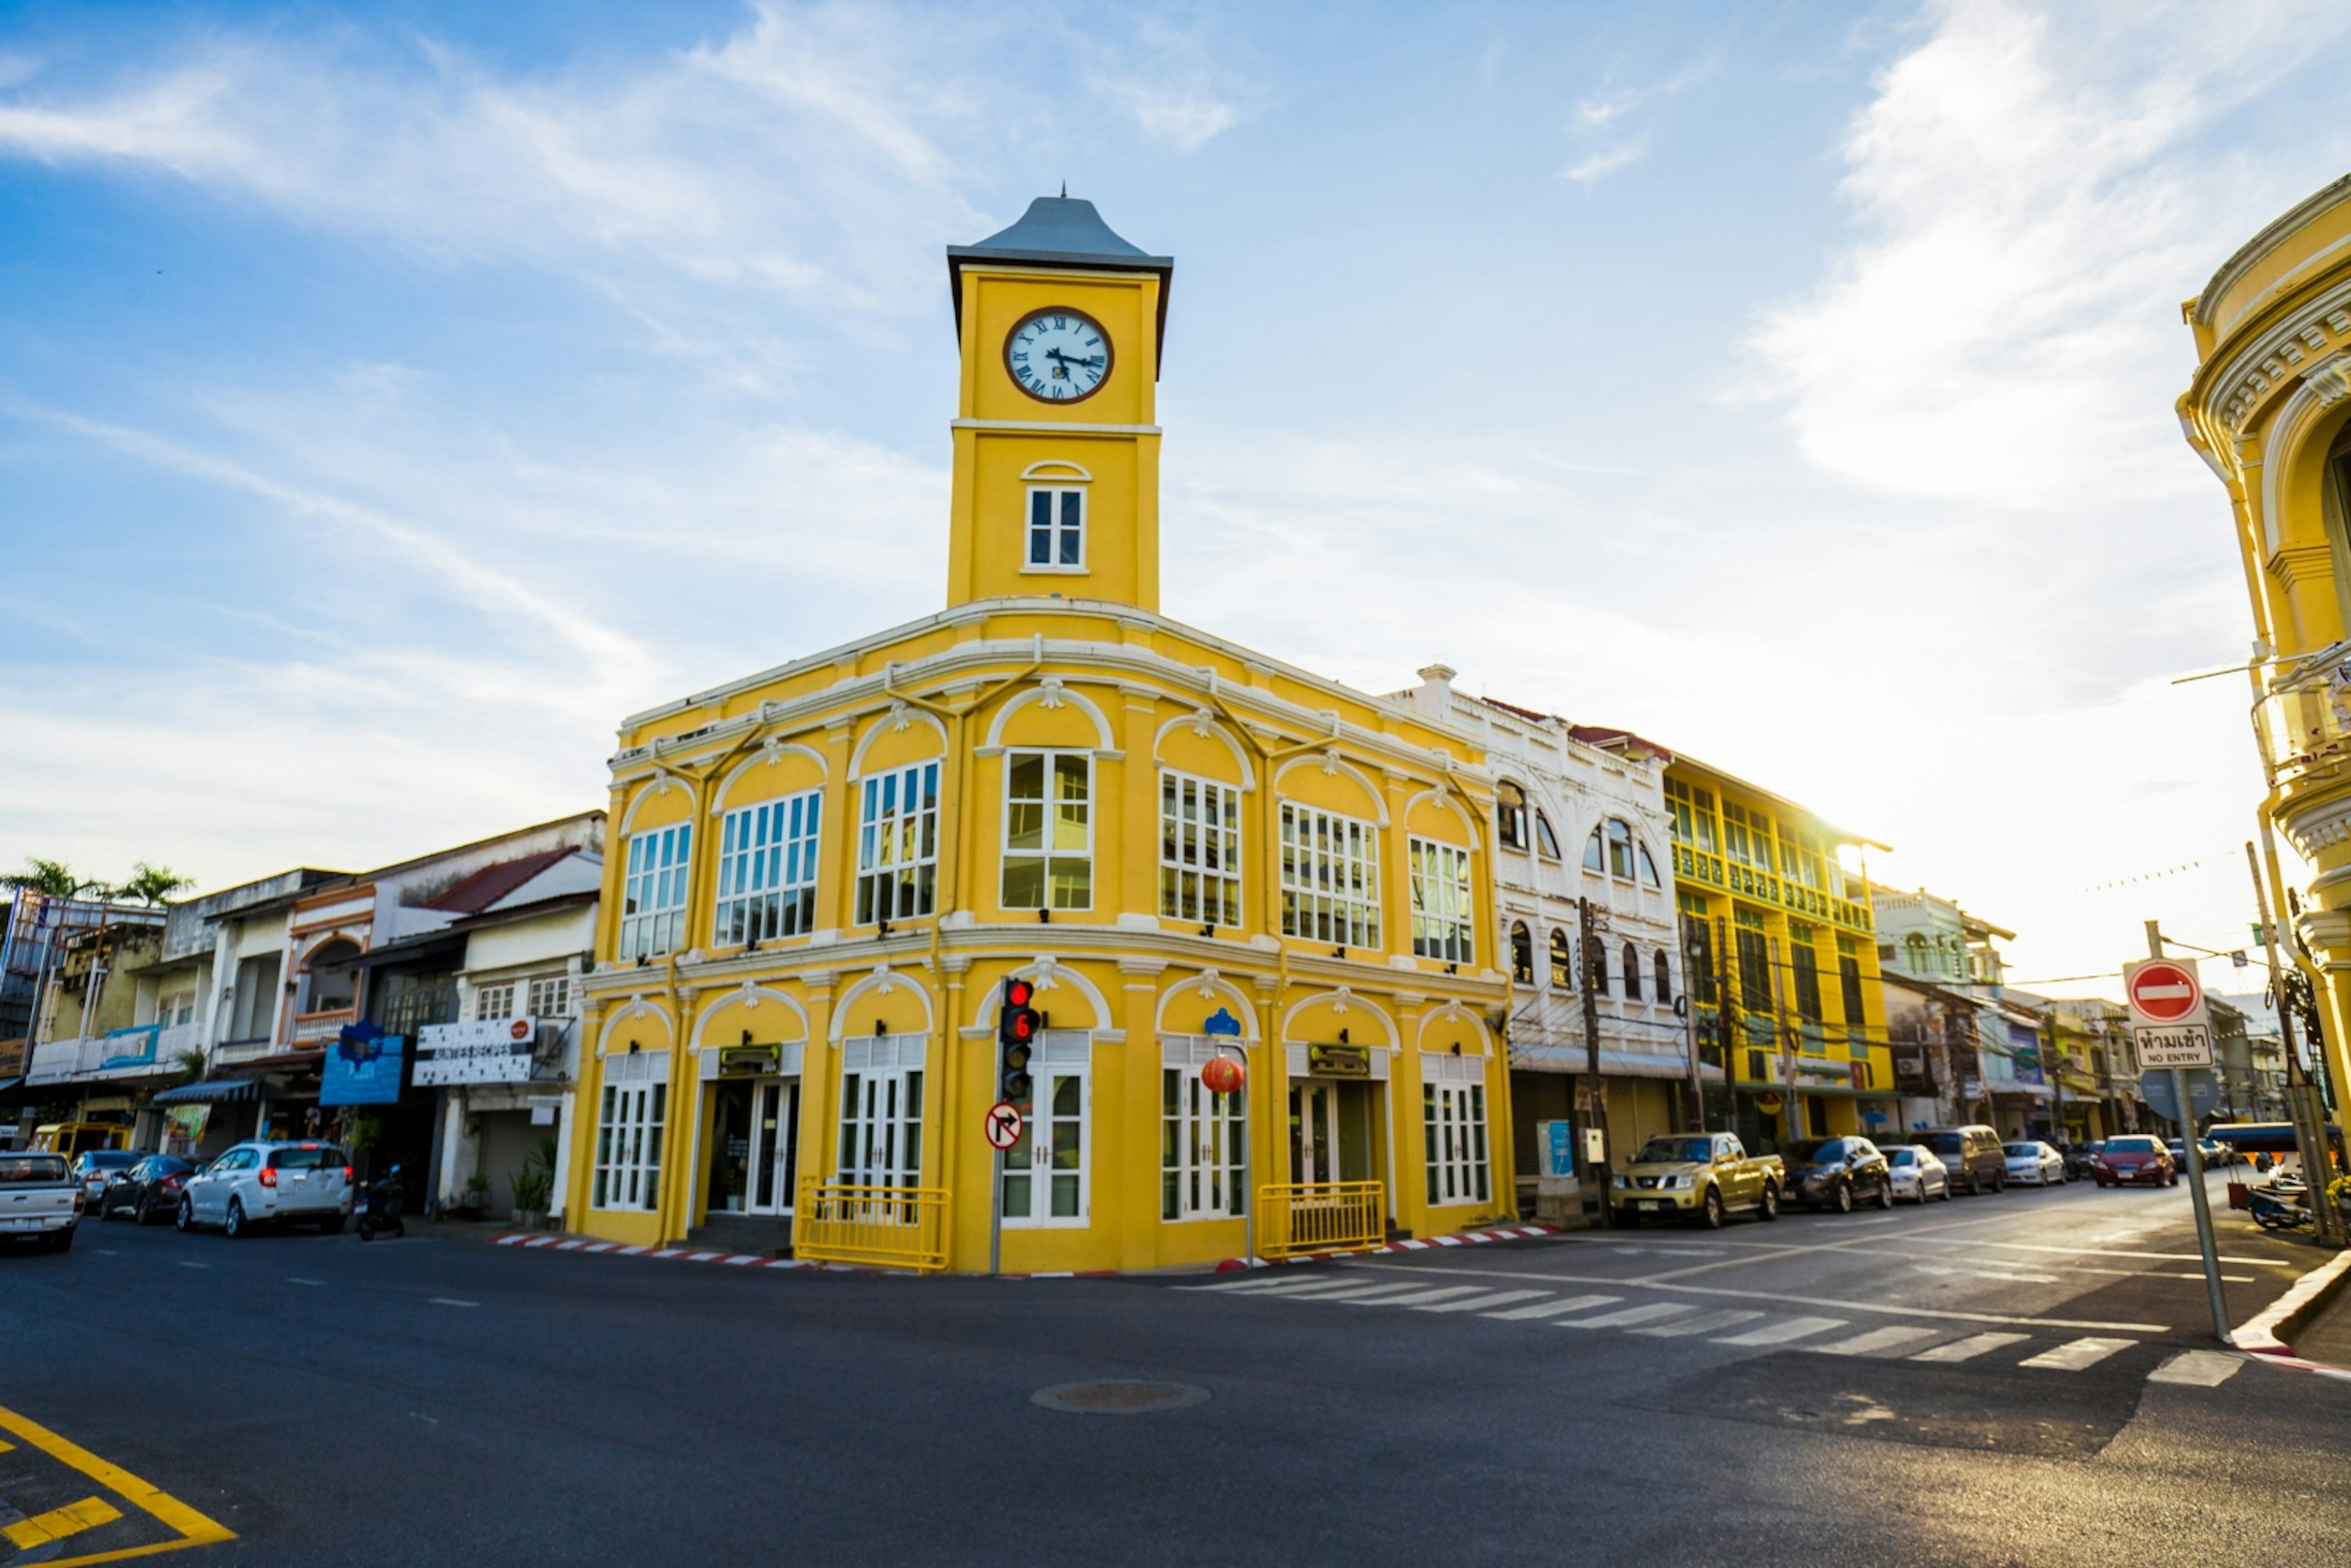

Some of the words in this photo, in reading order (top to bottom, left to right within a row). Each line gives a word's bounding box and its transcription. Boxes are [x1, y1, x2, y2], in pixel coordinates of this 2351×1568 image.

[1032, 319, 1049, 336] XI
[1053, 317, 1066, 330] XII
[1074, 323, 1084, 335] I
[1018, 333, 1034, 345] X
[1086, 336, 1100, 347] II
[1013, 351, 1028, 361] IX
[1085, 368, 1101, 384] IV
[1052, 384, 1065, 399] VI
[1016, 1013, 1029, 1038] 6
[2140, 1028, 2206, 1049] ห้ามเข้า
